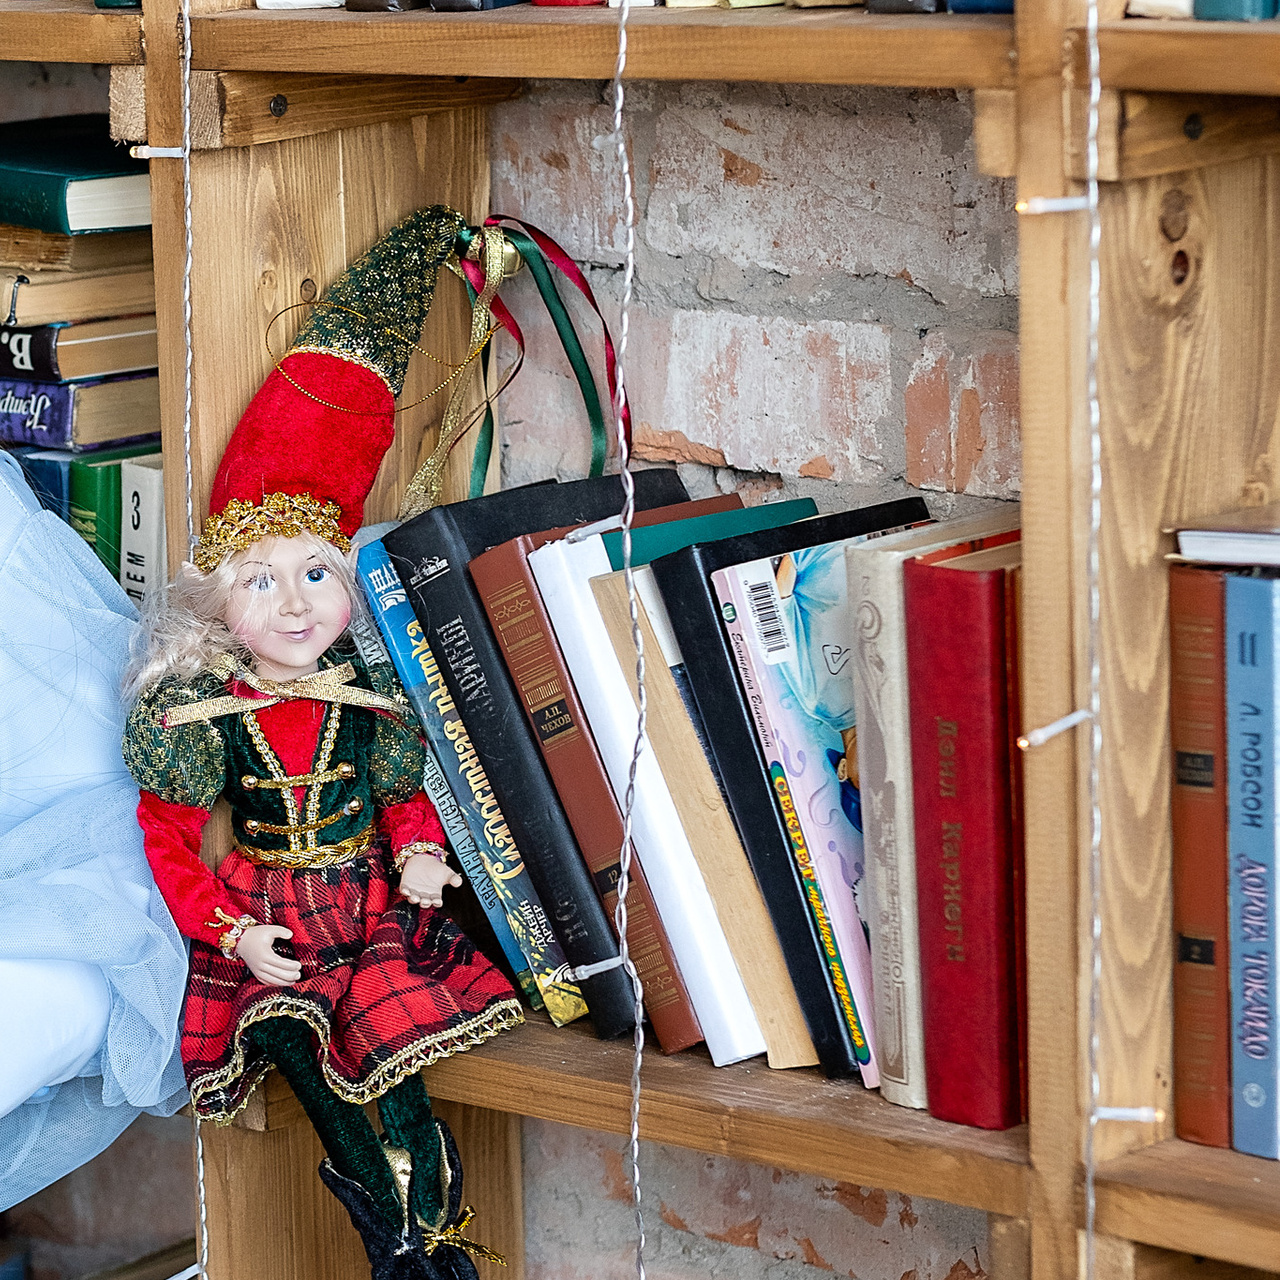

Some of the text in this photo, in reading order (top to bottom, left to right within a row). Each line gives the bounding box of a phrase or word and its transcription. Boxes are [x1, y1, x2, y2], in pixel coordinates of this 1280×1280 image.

[1, 333, 35, 371] В.
[130, 489, 141, 531] 3
[730, 631, 755, 693] Екатерина
[540, 713, 572, 734] ЧЕХОВ
[544, 704, 563, 721] А.П.
[1240, 731, 1263, 829] РОБСОН
[773, 775, 816, 885] СЕКРЕТ
[457, 828, 497, 911] ТАЙНА
[941, 822, 966, 962] Карнеги
[519, 898, 549, 949] ДЖЕЙН
[532, 904, 558, 945] АРЧЕР
